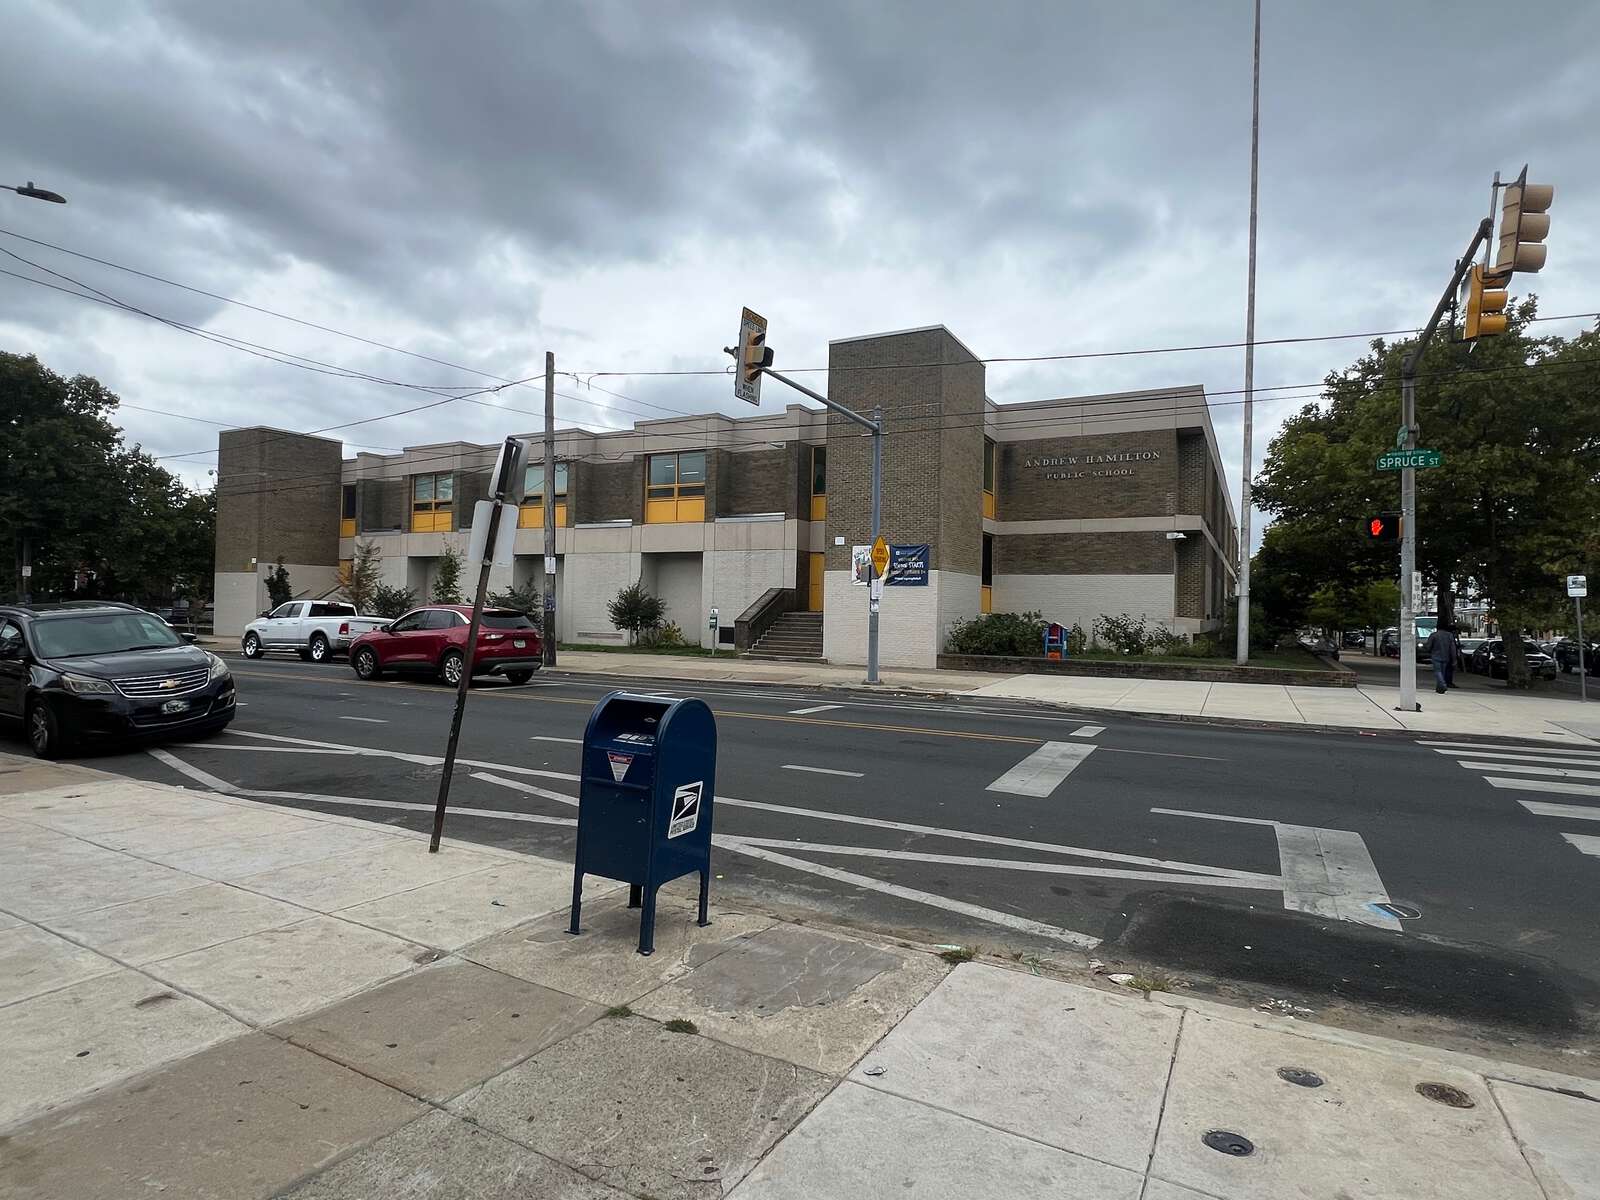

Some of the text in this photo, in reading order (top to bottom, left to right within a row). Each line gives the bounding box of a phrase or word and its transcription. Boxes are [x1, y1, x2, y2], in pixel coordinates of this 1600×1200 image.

[1024, 450, 1161, 468] ANDREW HAMILTON
[1379, 455, 1439, 468] SPRUCE ST
[1046, 468, 1135, 480] PUBLIC SCHOOL
